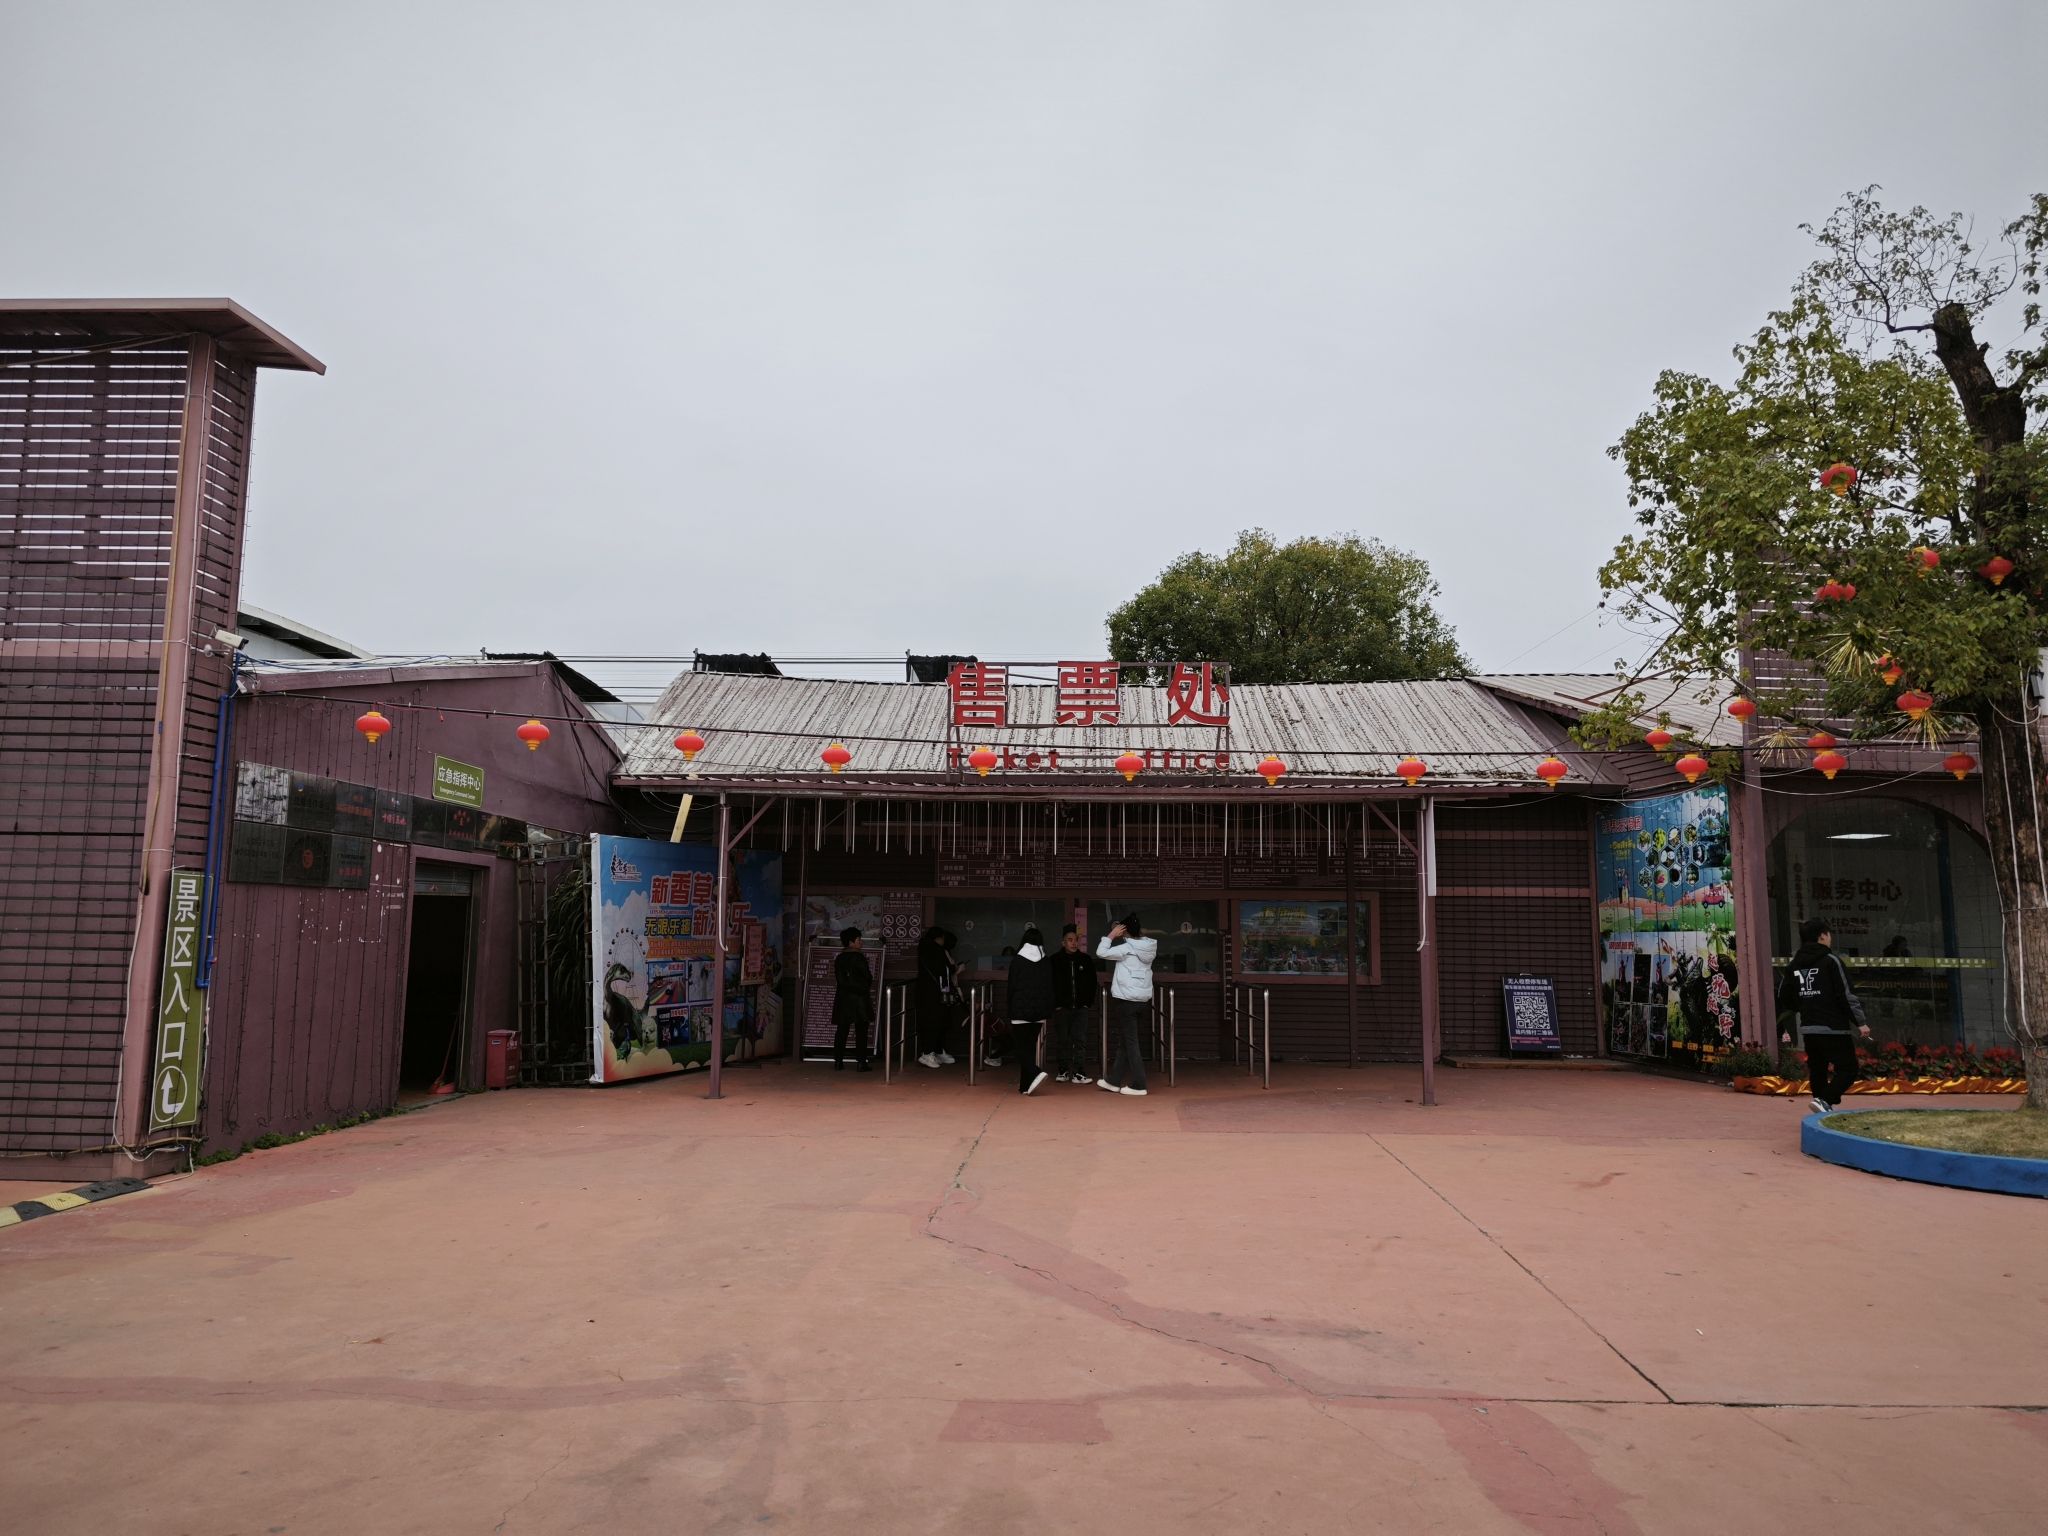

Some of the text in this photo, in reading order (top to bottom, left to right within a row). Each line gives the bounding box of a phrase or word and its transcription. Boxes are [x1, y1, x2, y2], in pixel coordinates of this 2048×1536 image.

[946, 660, 1231, 728] 售票处
[946, 747, 1232, 771] Tket ffice
[437, 765, 481, 791] 应急指挥中心
[650, 870, 715, 907] 新香草
[1812, 877, 1903, 901] 服务中心
[1818, 902, 1888, 912] Service Center
[644, 916, 692, 937] 无限乐趣
[160, 878, 199, 1063] 景区入口
